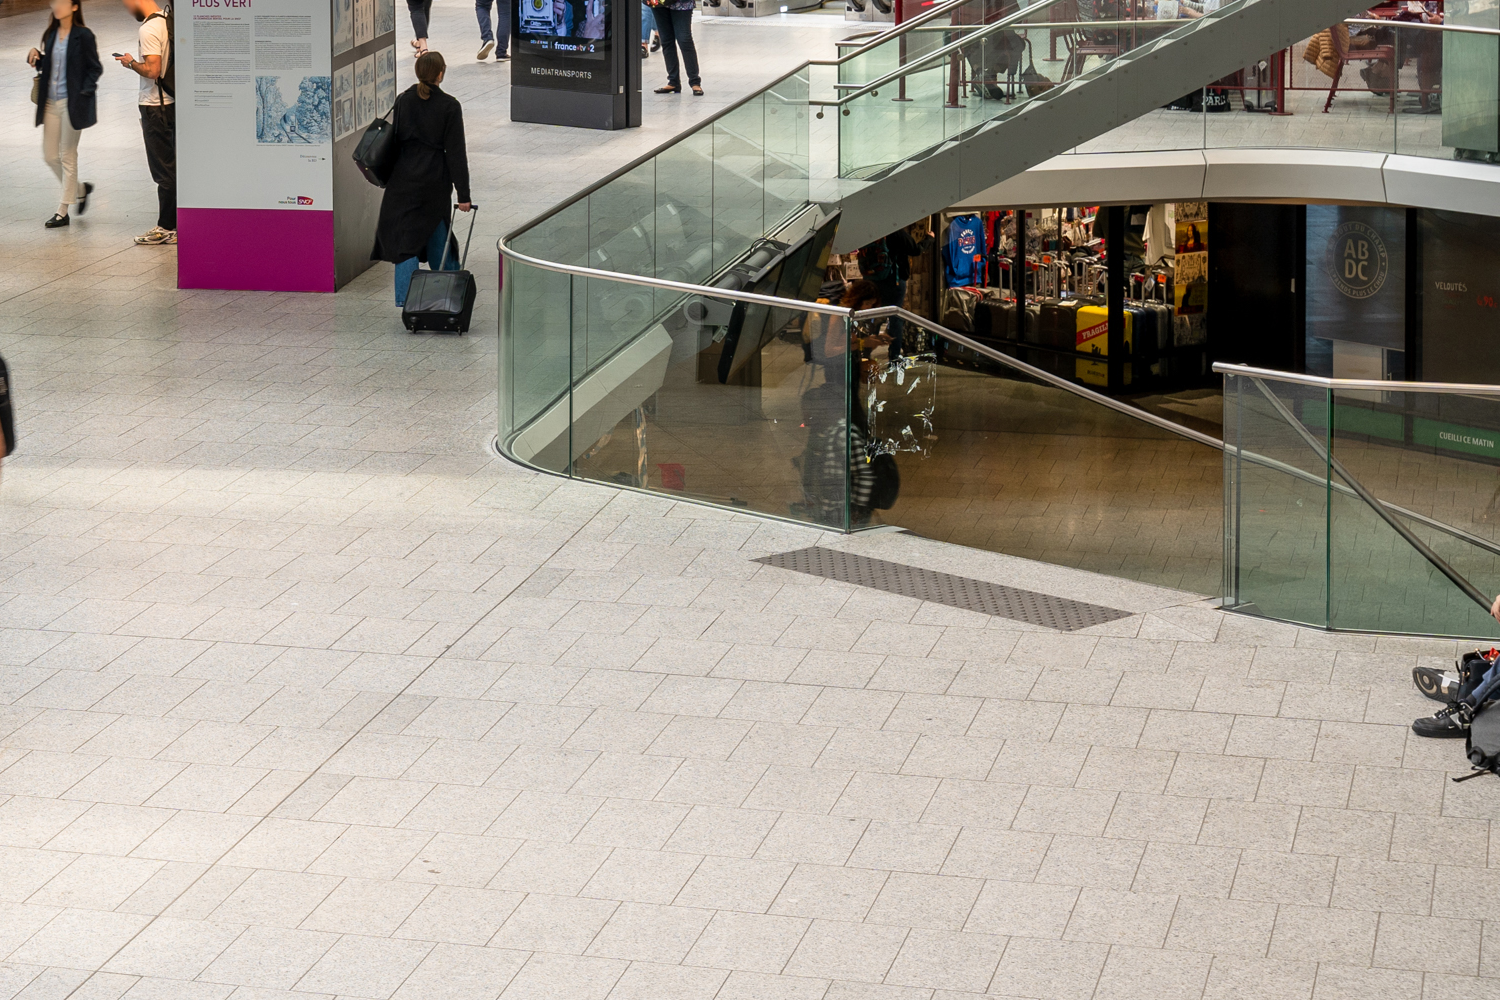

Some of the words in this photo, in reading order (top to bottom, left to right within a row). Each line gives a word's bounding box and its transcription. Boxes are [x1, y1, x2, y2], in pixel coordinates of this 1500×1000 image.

[531, 67, 592, 79] MEDIATRANSPORTS
[1344, 239, 1369, 260] AB
[1345, 259, 1368, 280] DC
[1435, 281, 1467, 292] VELOUTÉS
[1439, 432, 1462, 442] CUEILLI
[1463, 436, 1471, 444] CE
[1472, 438, 1494, 448] MATIN
